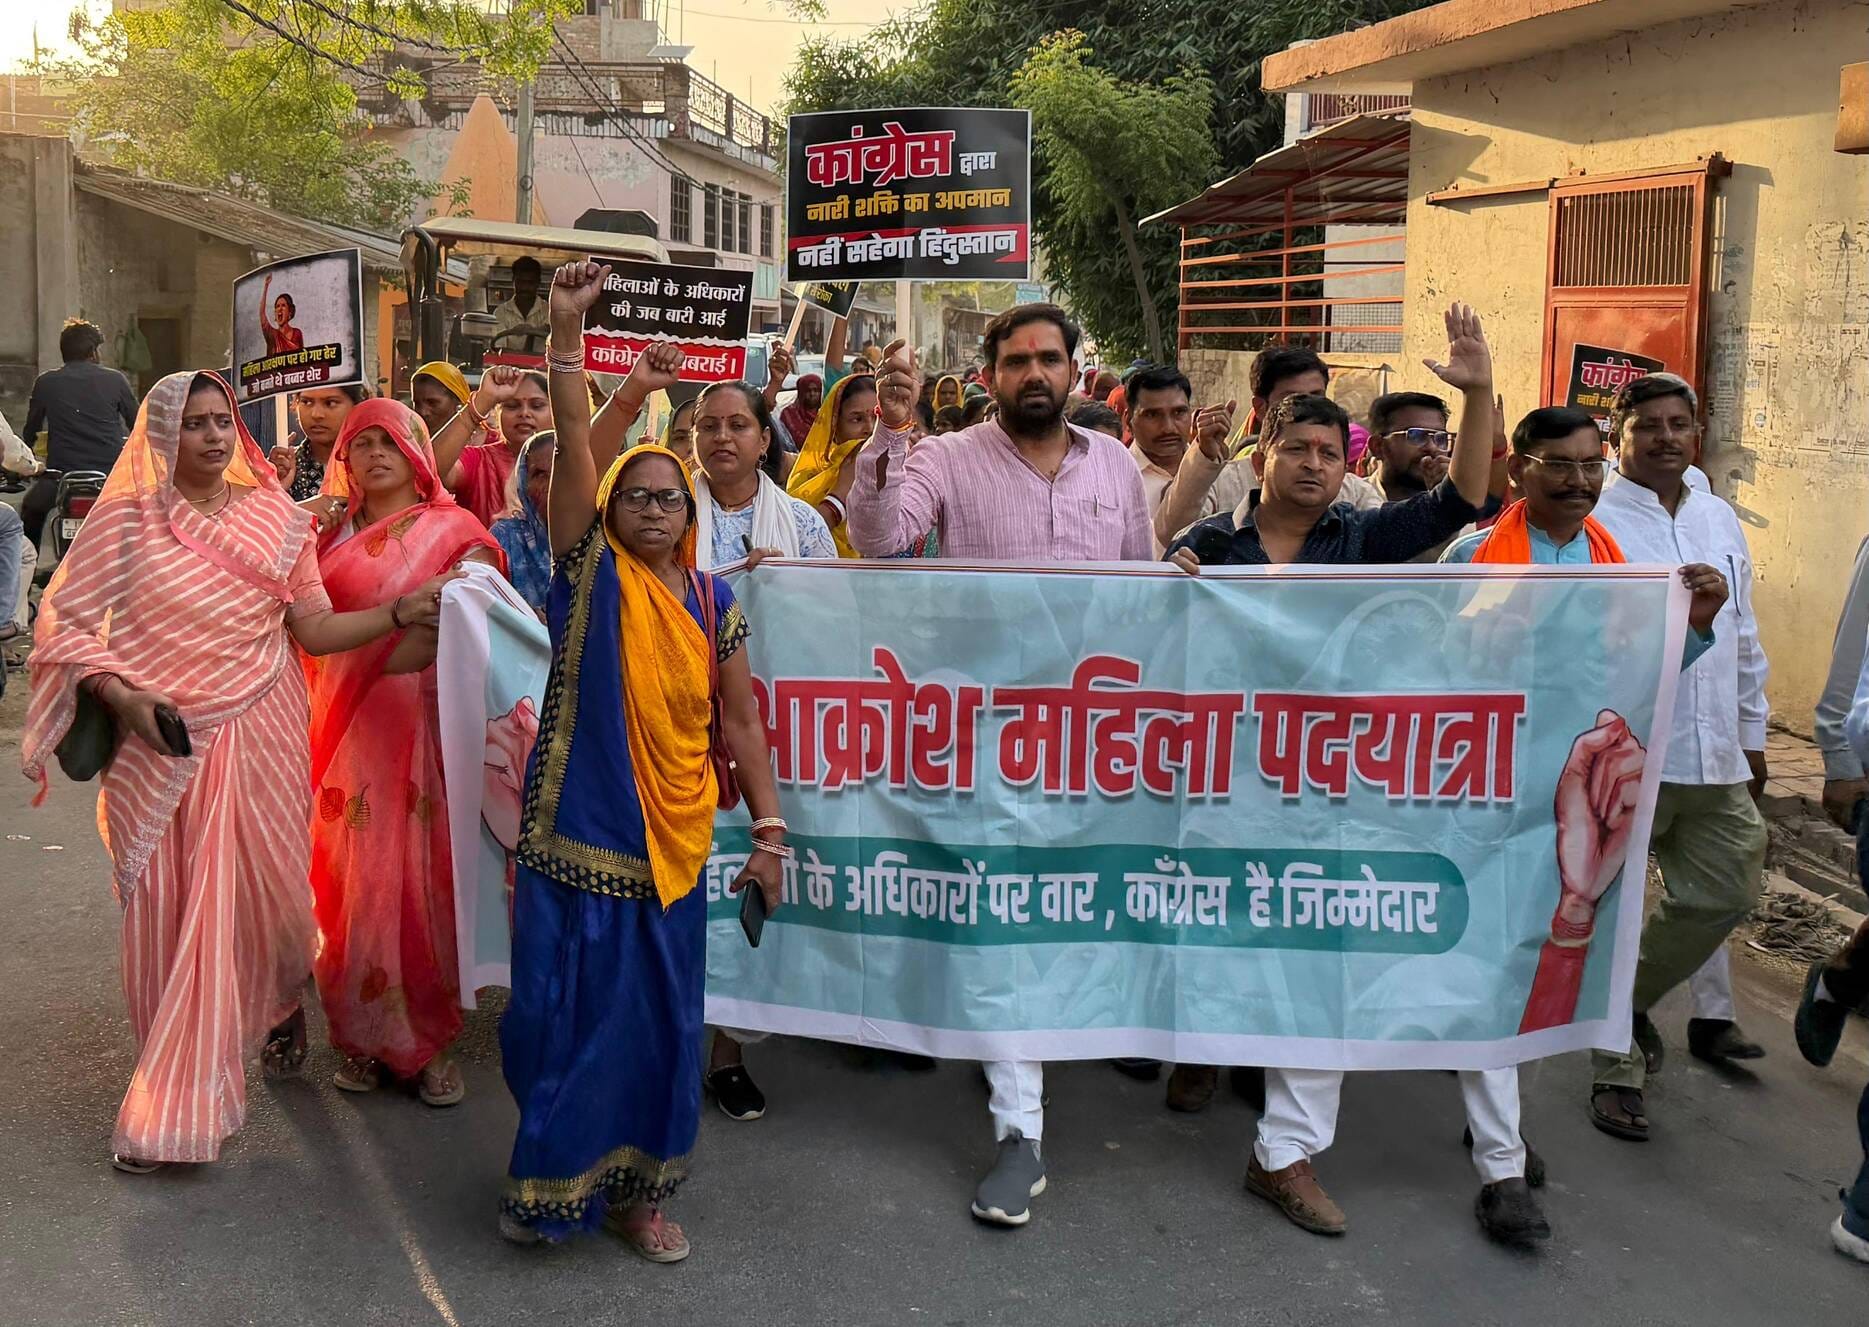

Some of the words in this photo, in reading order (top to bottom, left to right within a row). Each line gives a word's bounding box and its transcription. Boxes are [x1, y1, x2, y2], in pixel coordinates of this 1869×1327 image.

[805, 121, 956, 188] कांग्रेस
[959, 151, 997, 177] द्वारा
[806, 194, 850, 222] नारी
[855, 190, 900, 217] शक्ति
[903, 192, 930, 213] का
[935, 188, 1012, 210] अपमान
[797, 237, 845, 268] नहीं
[845, 233, 915, 263] सहेगा
[919, 227, 1018, 265] हिंदुस्तान
[663, 278, 680, 297] के
[684, 282, 746, 303] अधिकारों
[610, 300, 632, 319] की
[636, 305, 662, 321] जब
[665, 305, 696, 325] बारी
[698, 308, 728, 328] आई
[287, 354, 298, 365] पर
[299, 349, 308, 363] हो
[309, 349, 323, 361] गए
[323, 346, 336, 359] ढेर
[275, 372, 283, 386] थे
[306, 367, 321, 381] शेर
[991, 652, 1246, 799] महिला
[1252, 689, 1527, 803] पदयात्रा
[803, 848, 836, 911] के
[845, 850, 986, 926] अधिकारों
[986, 873, 1034, 924] पर
[1245, 861, 1274, 928] है
[1278, 862, 1440, 934] जिम्मेदार
